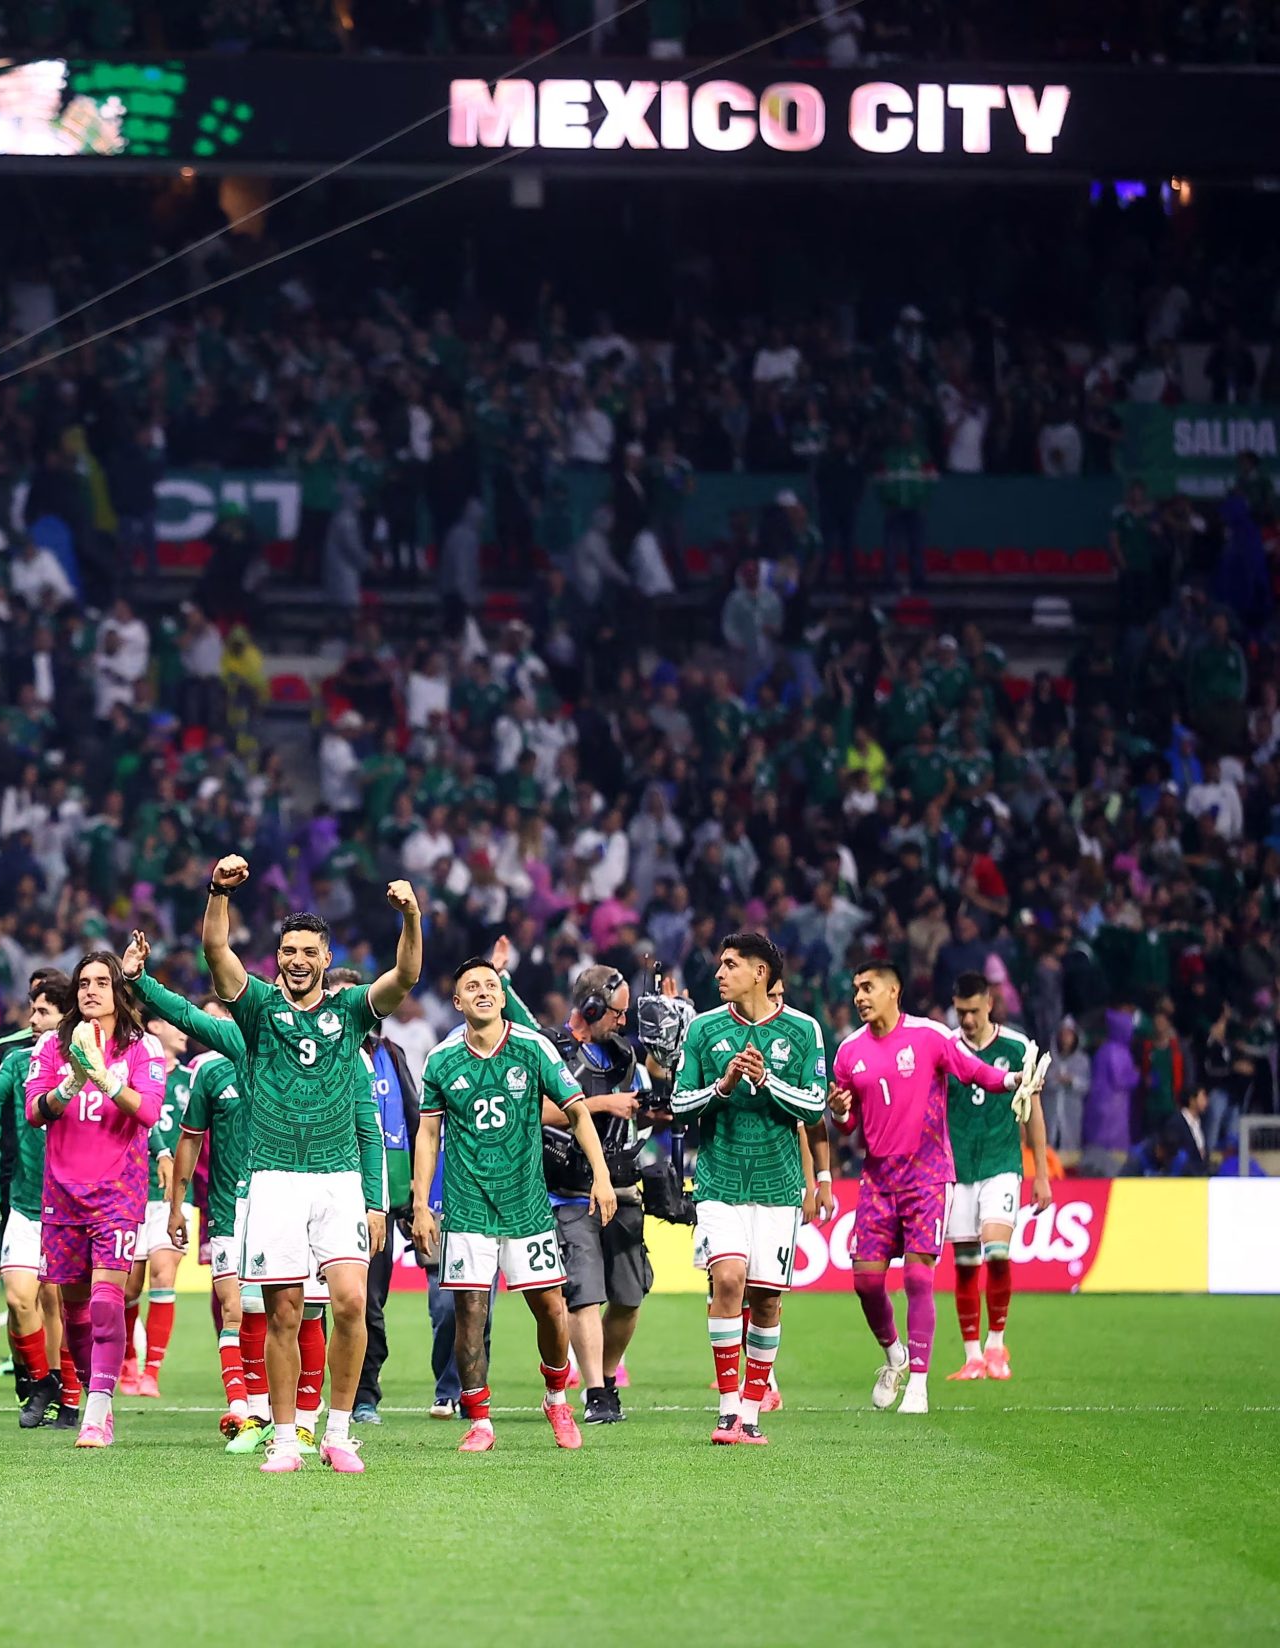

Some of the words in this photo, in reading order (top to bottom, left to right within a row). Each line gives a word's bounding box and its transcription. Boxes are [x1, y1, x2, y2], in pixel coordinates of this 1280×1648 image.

[448, 78, 826, 152] MEXICO
[848, 81, 1071, 154] CITY
[298, 1038, 316, 1066] 9
[78, 1090, 103, 1122] 12
[879, 1077, 891, 1106] 1
[473, 1096, 507, 1130] 25
[1003, 1193, 1014, 1213] 3
[113, 1229, 136, 1262] 12
[934, 1218, 942, 1247] 1
[526, 1239, 556, 1271] 25
[777, 1246, 790, 1276] 4
